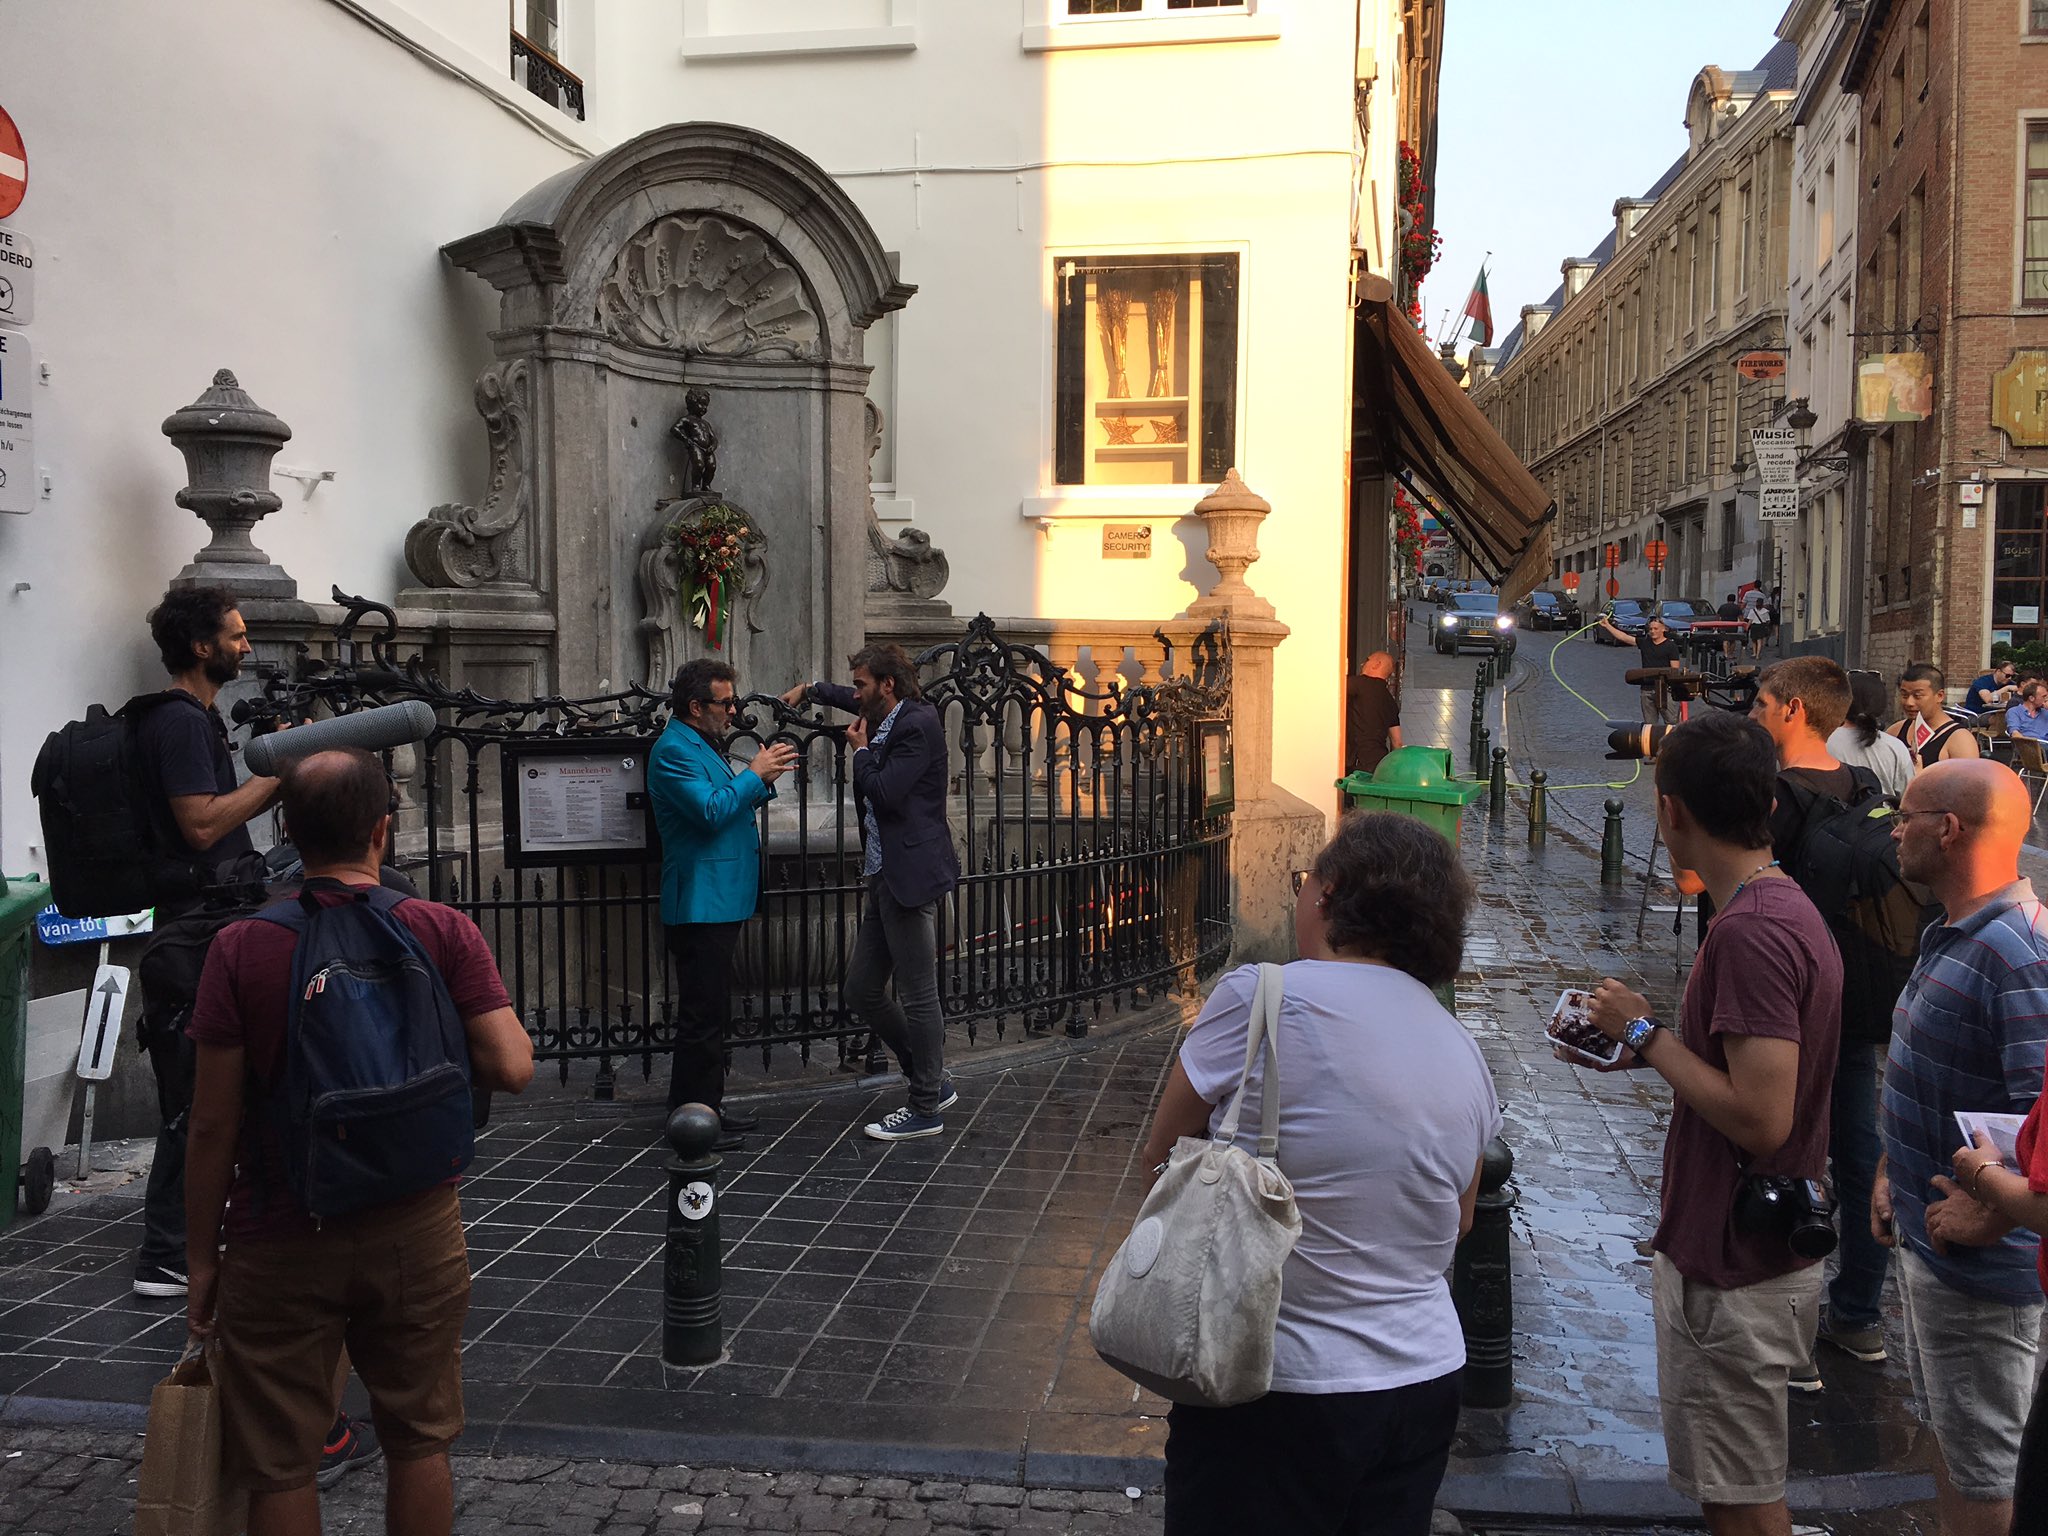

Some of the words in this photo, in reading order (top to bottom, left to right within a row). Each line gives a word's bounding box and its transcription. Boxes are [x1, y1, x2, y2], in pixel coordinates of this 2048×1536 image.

[1740, 359, 1784, 368] FIREWORKS
[1752, 429, 1795, 439] Music
[559, 766, 612, 776] Manneken-Pis
